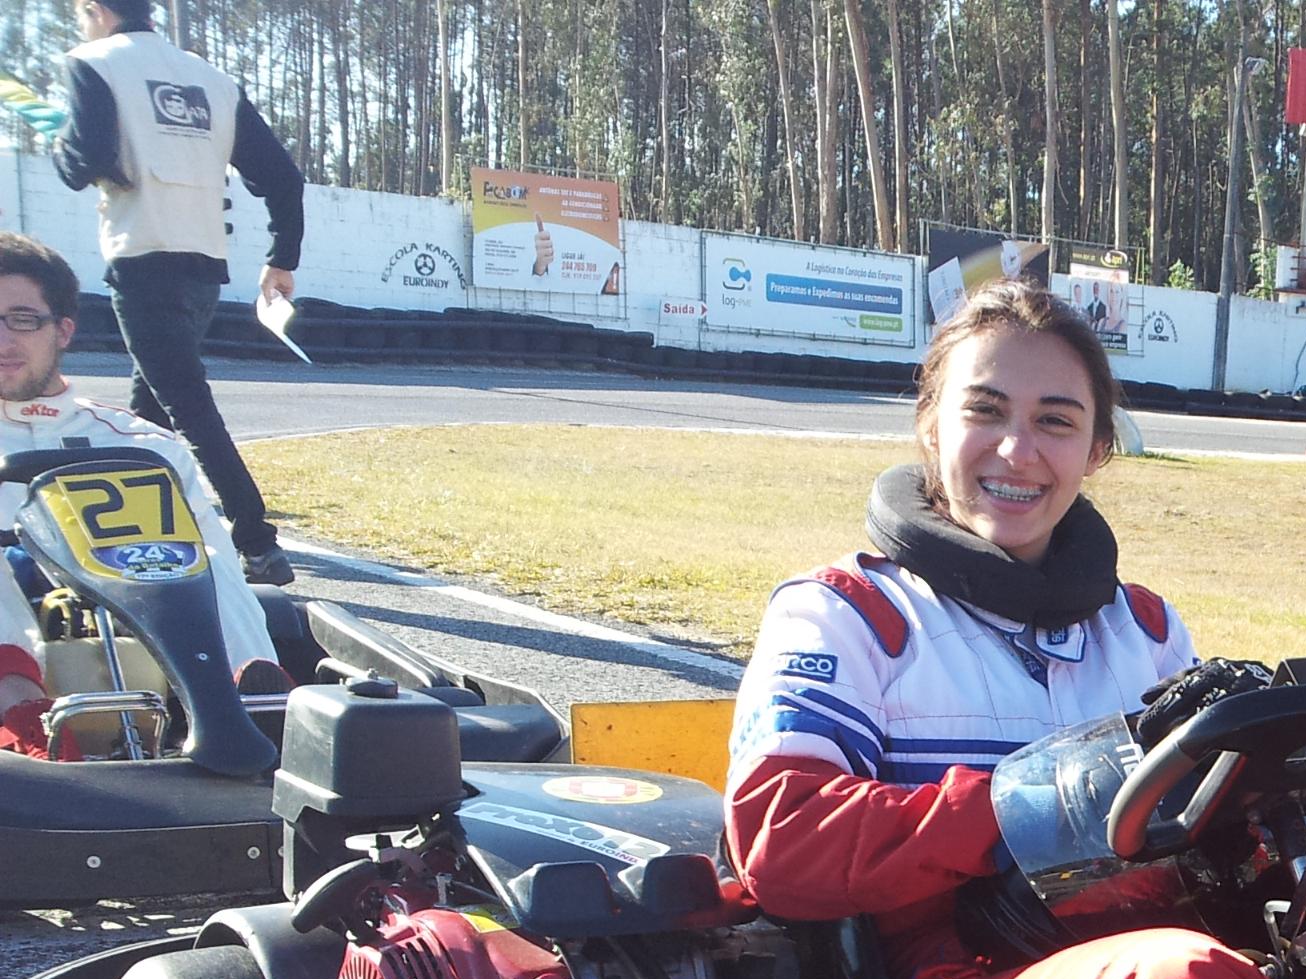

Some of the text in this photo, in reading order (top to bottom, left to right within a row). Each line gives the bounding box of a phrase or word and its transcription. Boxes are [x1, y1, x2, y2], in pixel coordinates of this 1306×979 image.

[381, 242, 418, 283] ESCOLA
[403, 276, 449, 288] EUROINDY
[63, 473, 175, 540] 27
[123, 546, 165, 563] 24
